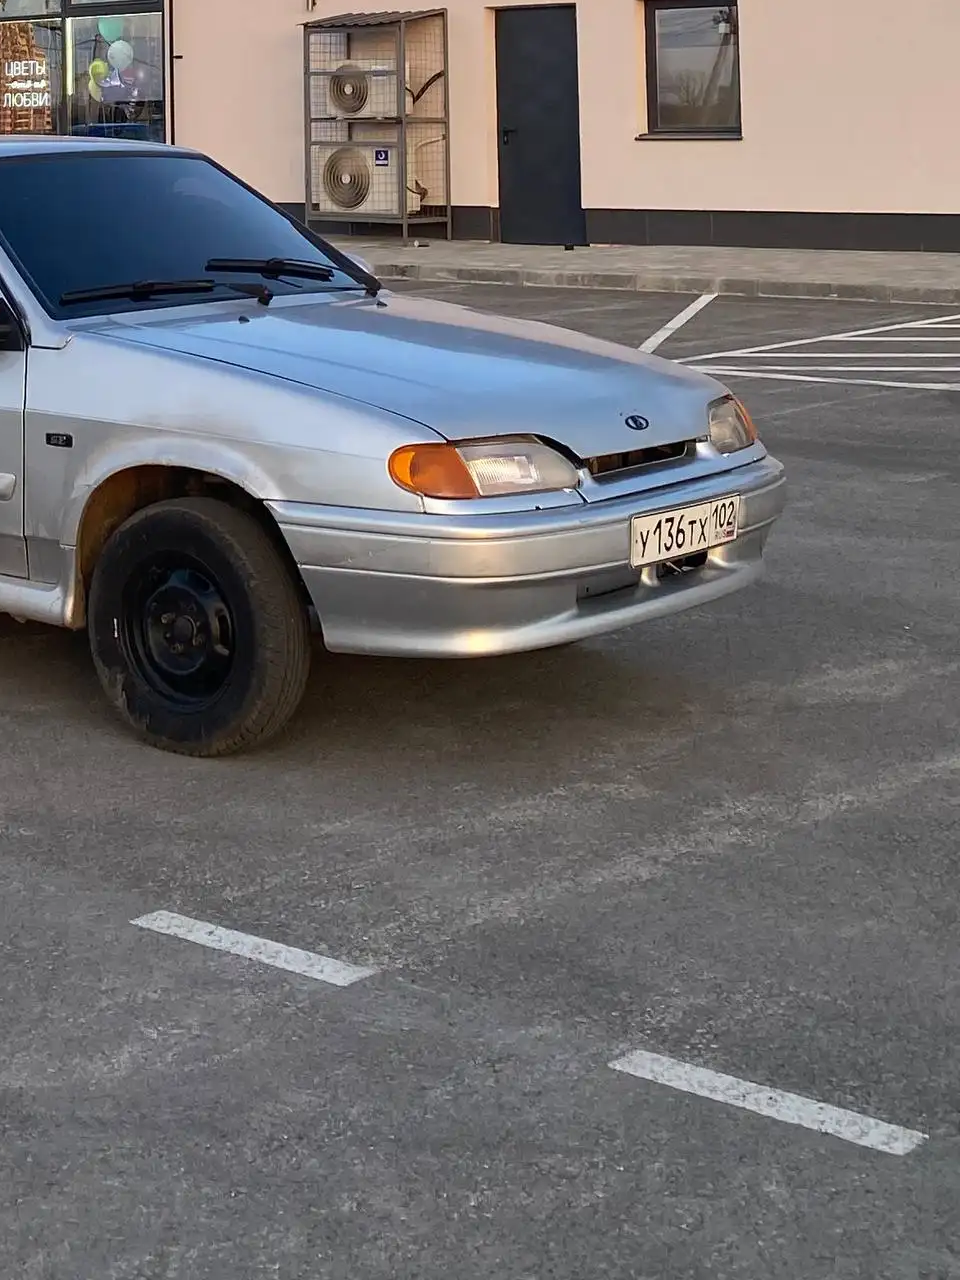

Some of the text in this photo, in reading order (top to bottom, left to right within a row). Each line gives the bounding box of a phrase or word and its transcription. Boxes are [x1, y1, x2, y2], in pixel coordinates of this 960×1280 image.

[5, 60, 46, 78] ЦВЕТЫ
[3, 92, 49, 108] ЛЮБВИ
[712, 501, 735, 530] 102
